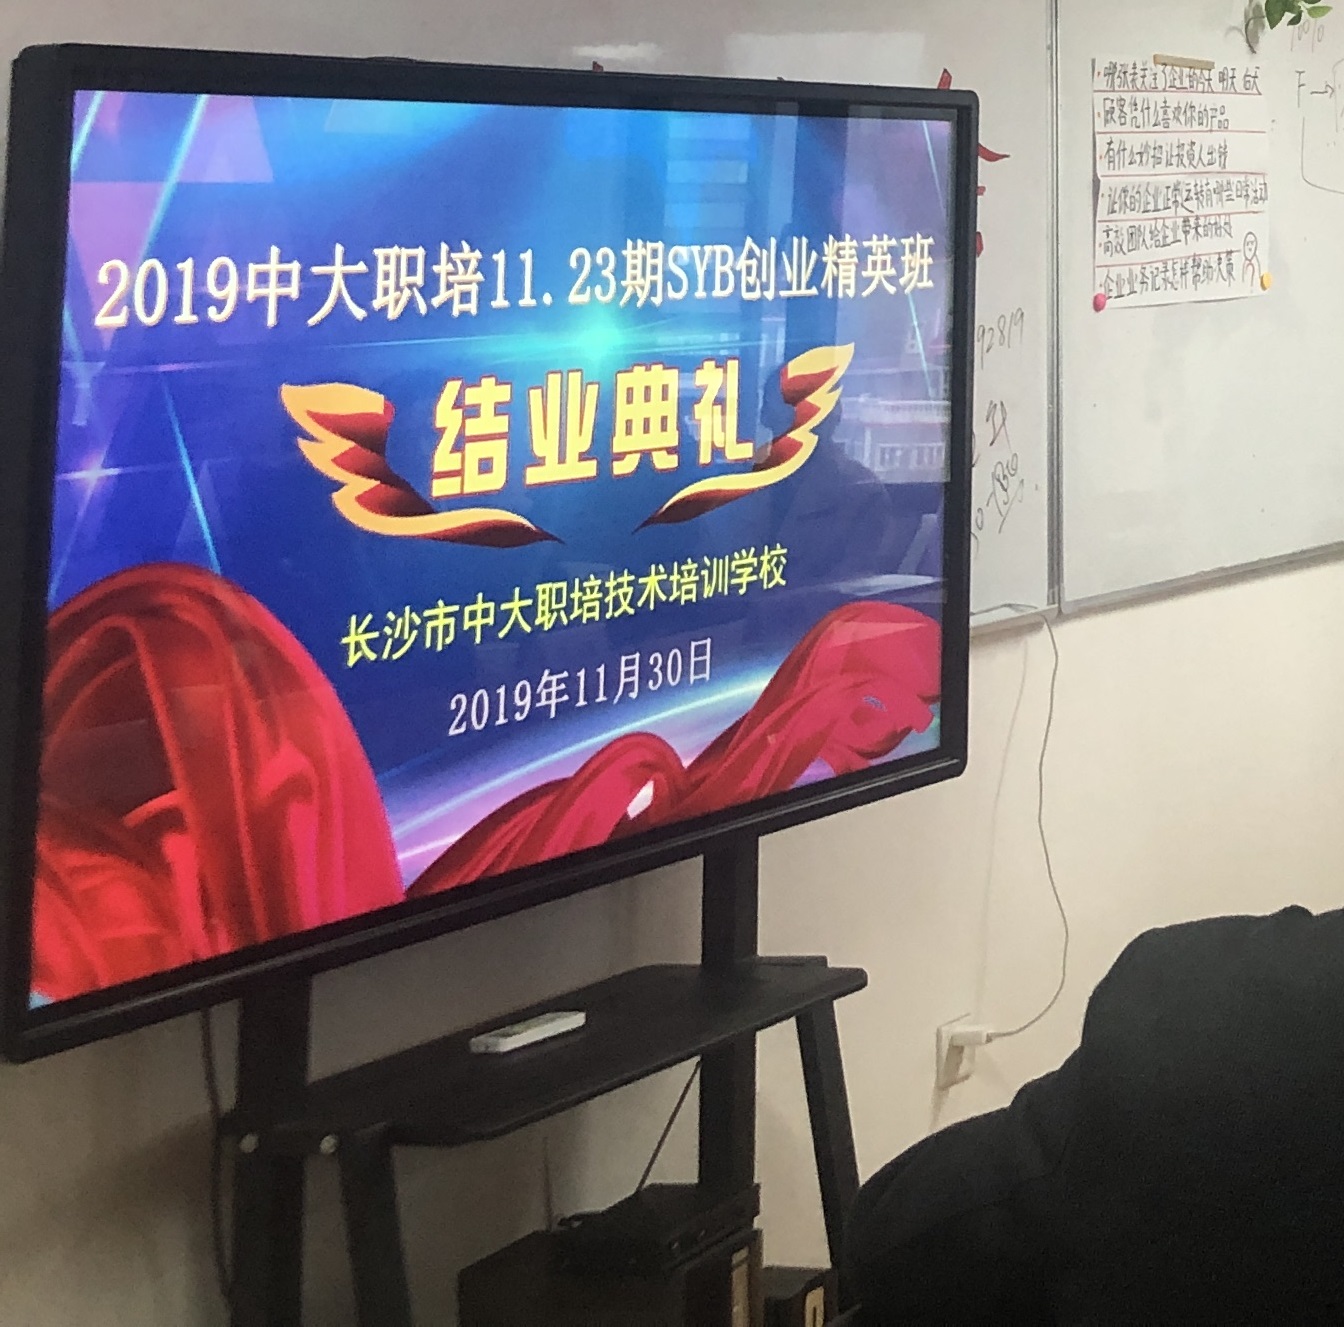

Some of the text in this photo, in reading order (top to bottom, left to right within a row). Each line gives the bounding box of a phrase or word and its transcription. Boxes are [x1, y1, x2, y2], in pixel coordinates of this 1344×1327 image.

[430, 356, 754, 500] 结业典礼
[341, 543, 788, 669] 长沙市中大职培技术培训学校
[448, 637, 713, 737] 2019年11月30日
